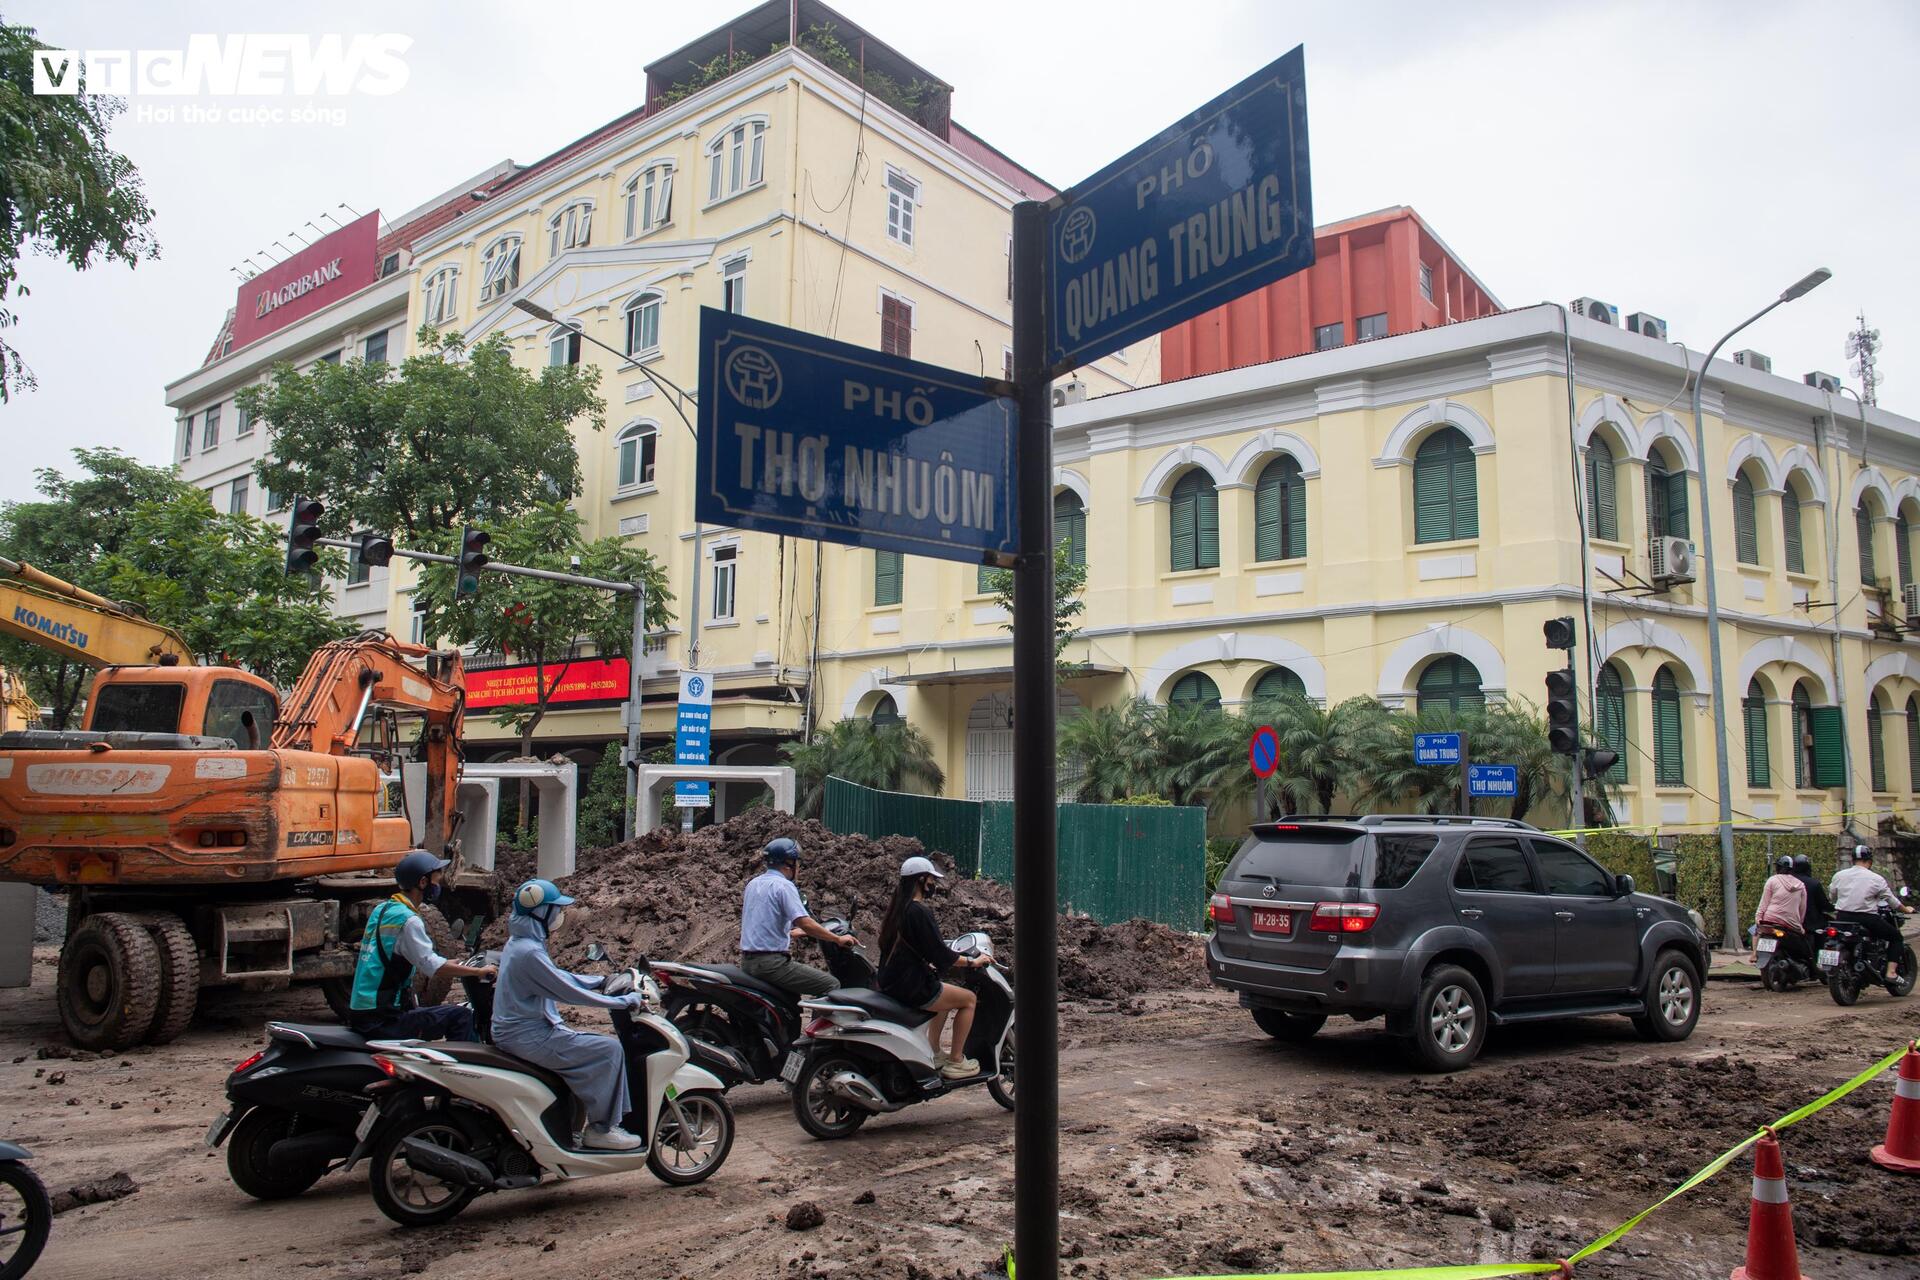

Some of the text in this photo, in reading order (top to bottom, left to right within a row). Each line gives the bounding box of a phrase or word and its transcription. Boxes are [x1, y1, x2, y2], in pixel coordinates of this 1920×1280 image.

[1136, 124, 1217, 210] PHỐ
[1064, 173, 1282, 341] QUANG TRUNG
[269, 257, 343, 310] AGRIBANK
[843, 379, 938, 427] PHỐ
[734, 422, 995, 538] THỢ NHUỘM
[14, 605, 88, 648] KOMATSU
[1419, 748, 1458, 760] QUANG TRUNG
[1432, 735, 1447, 744] PHỐ
[1472, 778, 1513, 793] THỢ NHUỘM
[1487, 767, 1503, 776] PHỐ
